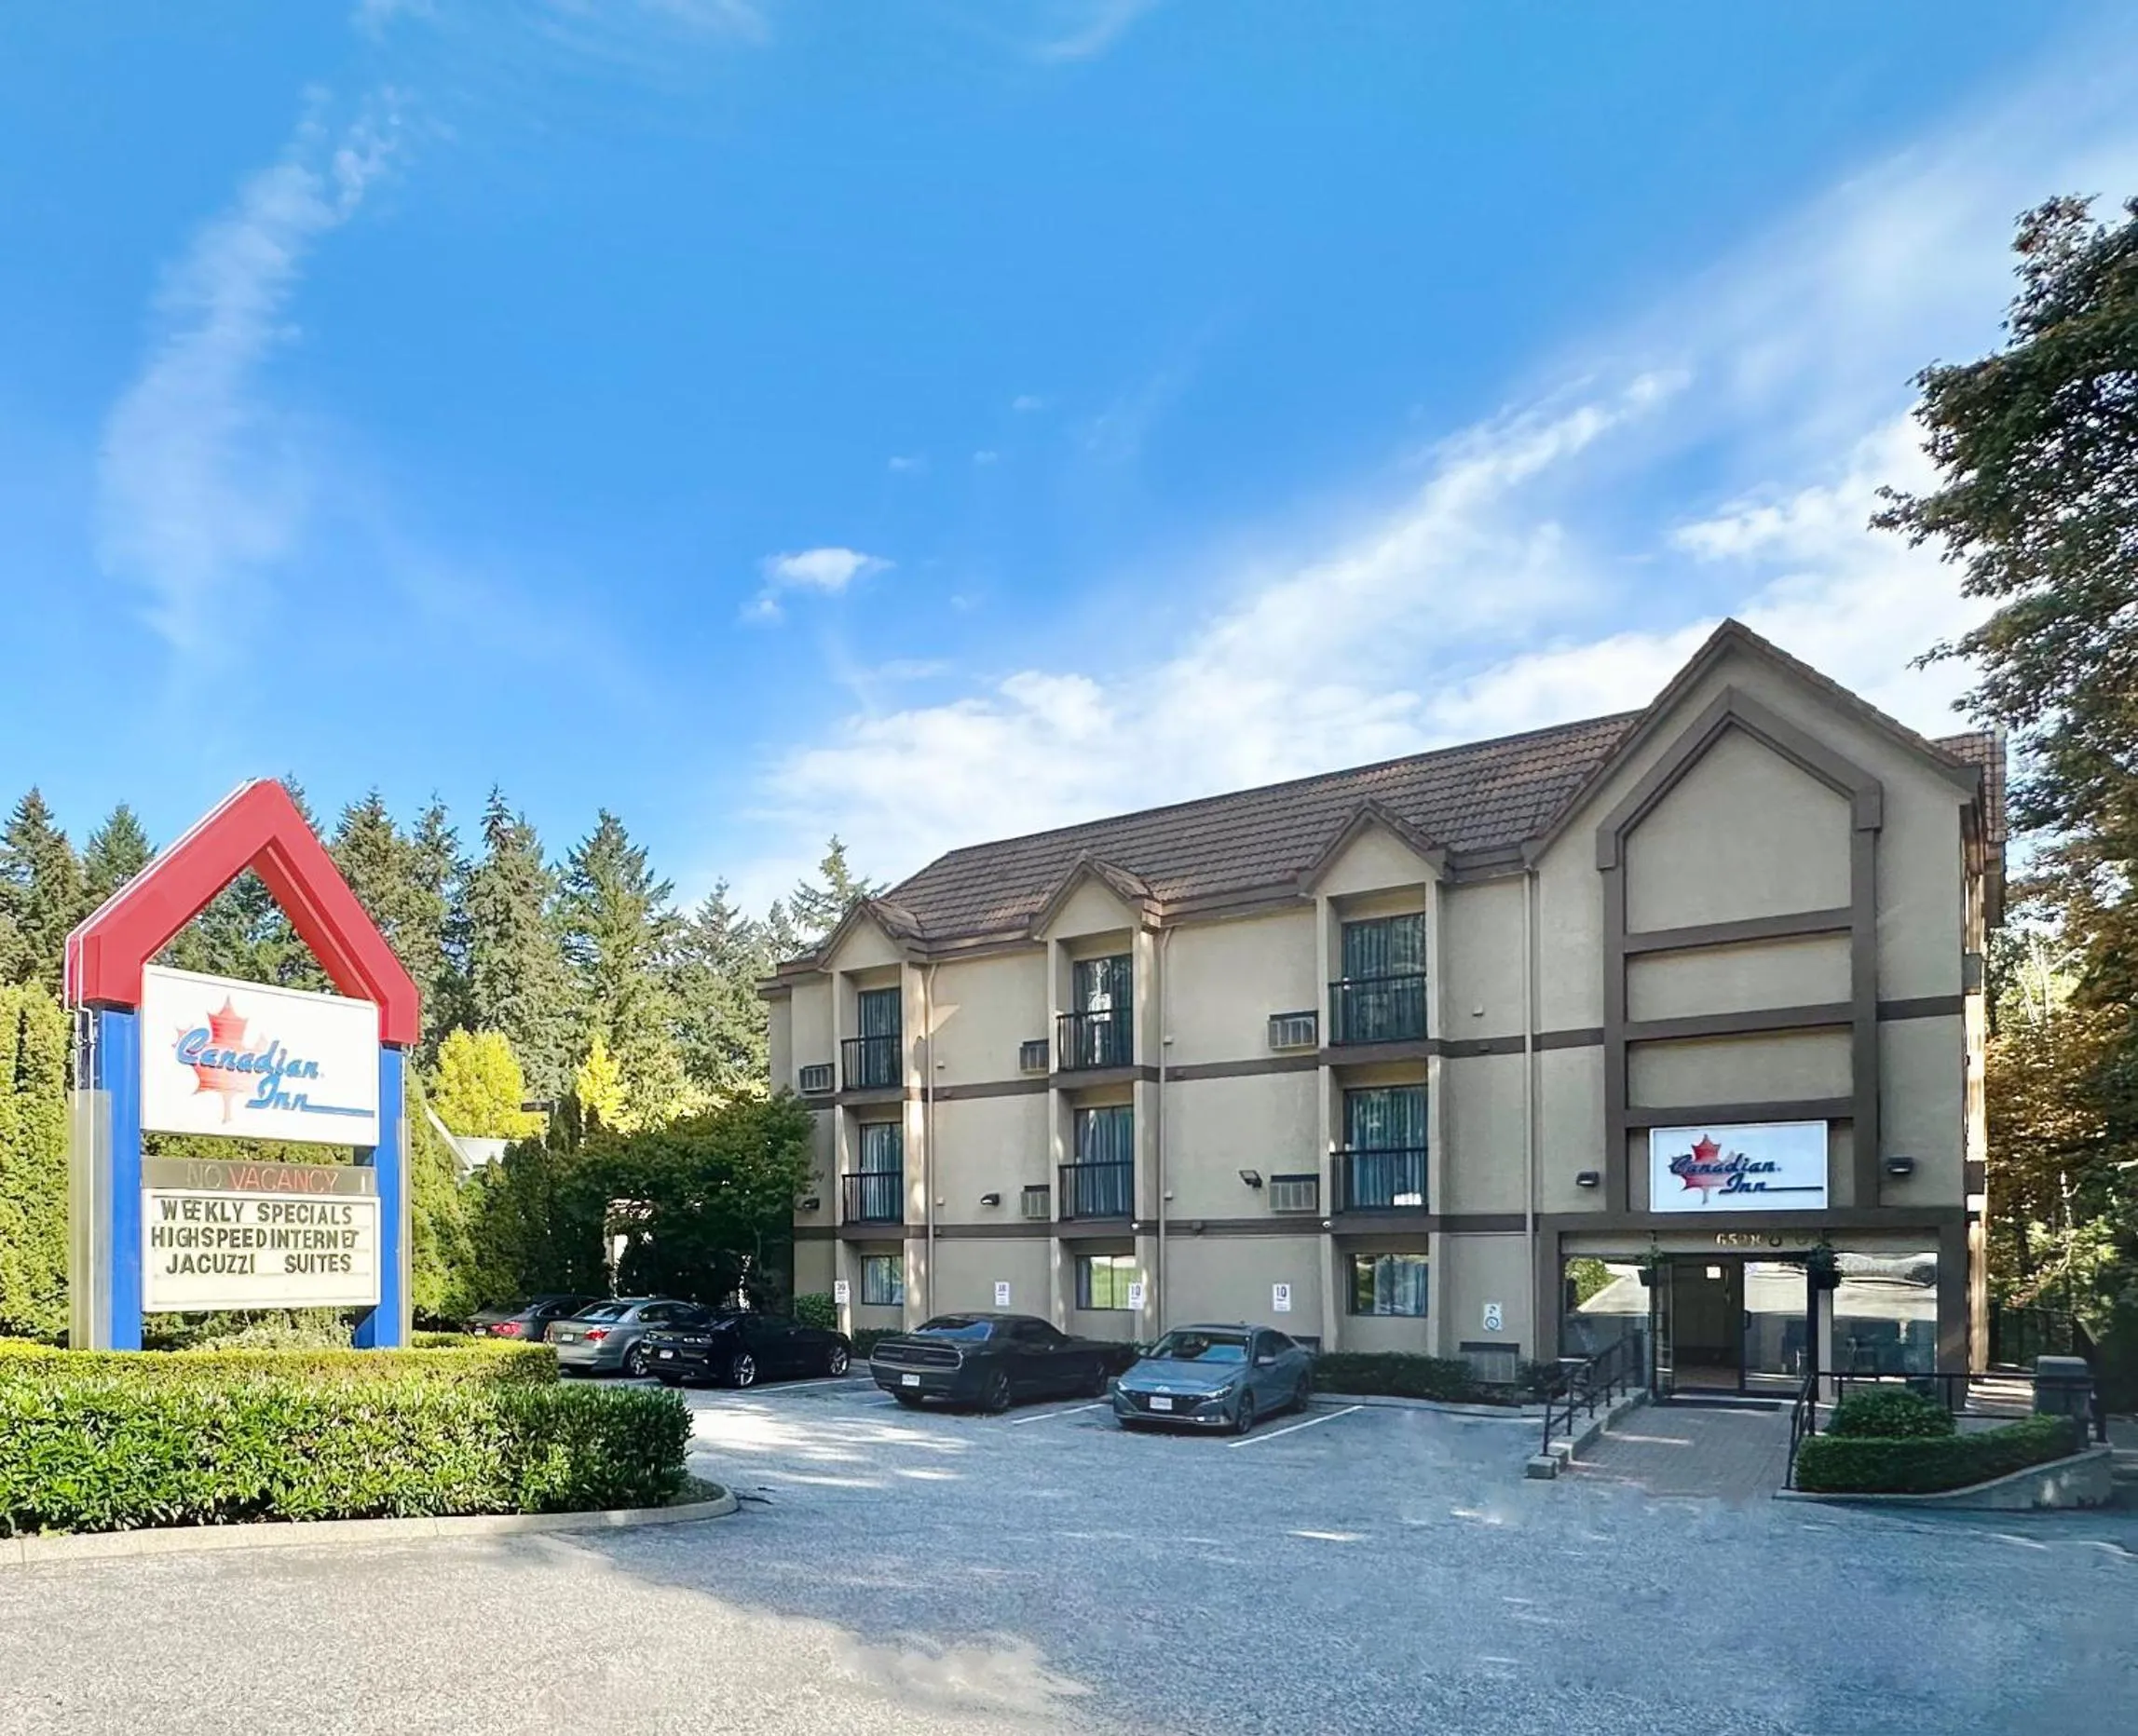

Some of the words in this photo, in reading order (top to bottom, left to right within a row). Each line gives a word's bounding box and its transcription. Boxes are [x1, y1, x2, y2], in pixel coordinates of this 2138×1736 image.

[176, 1028, 320, 1079] Canadian
[1669, 1153, 1776, 1175] Canadian
[187, 1163, 222, 1189] NO
[228, 1167, 339, 1193] VACANCY
[160, 1200, 244, 1223] WEEKLY
[257, 1202, 352, 1225] SPECIALS
[166, 1254, 255, 1275] JACUZZI
[284, 1255, 352, 1274] SUITES
